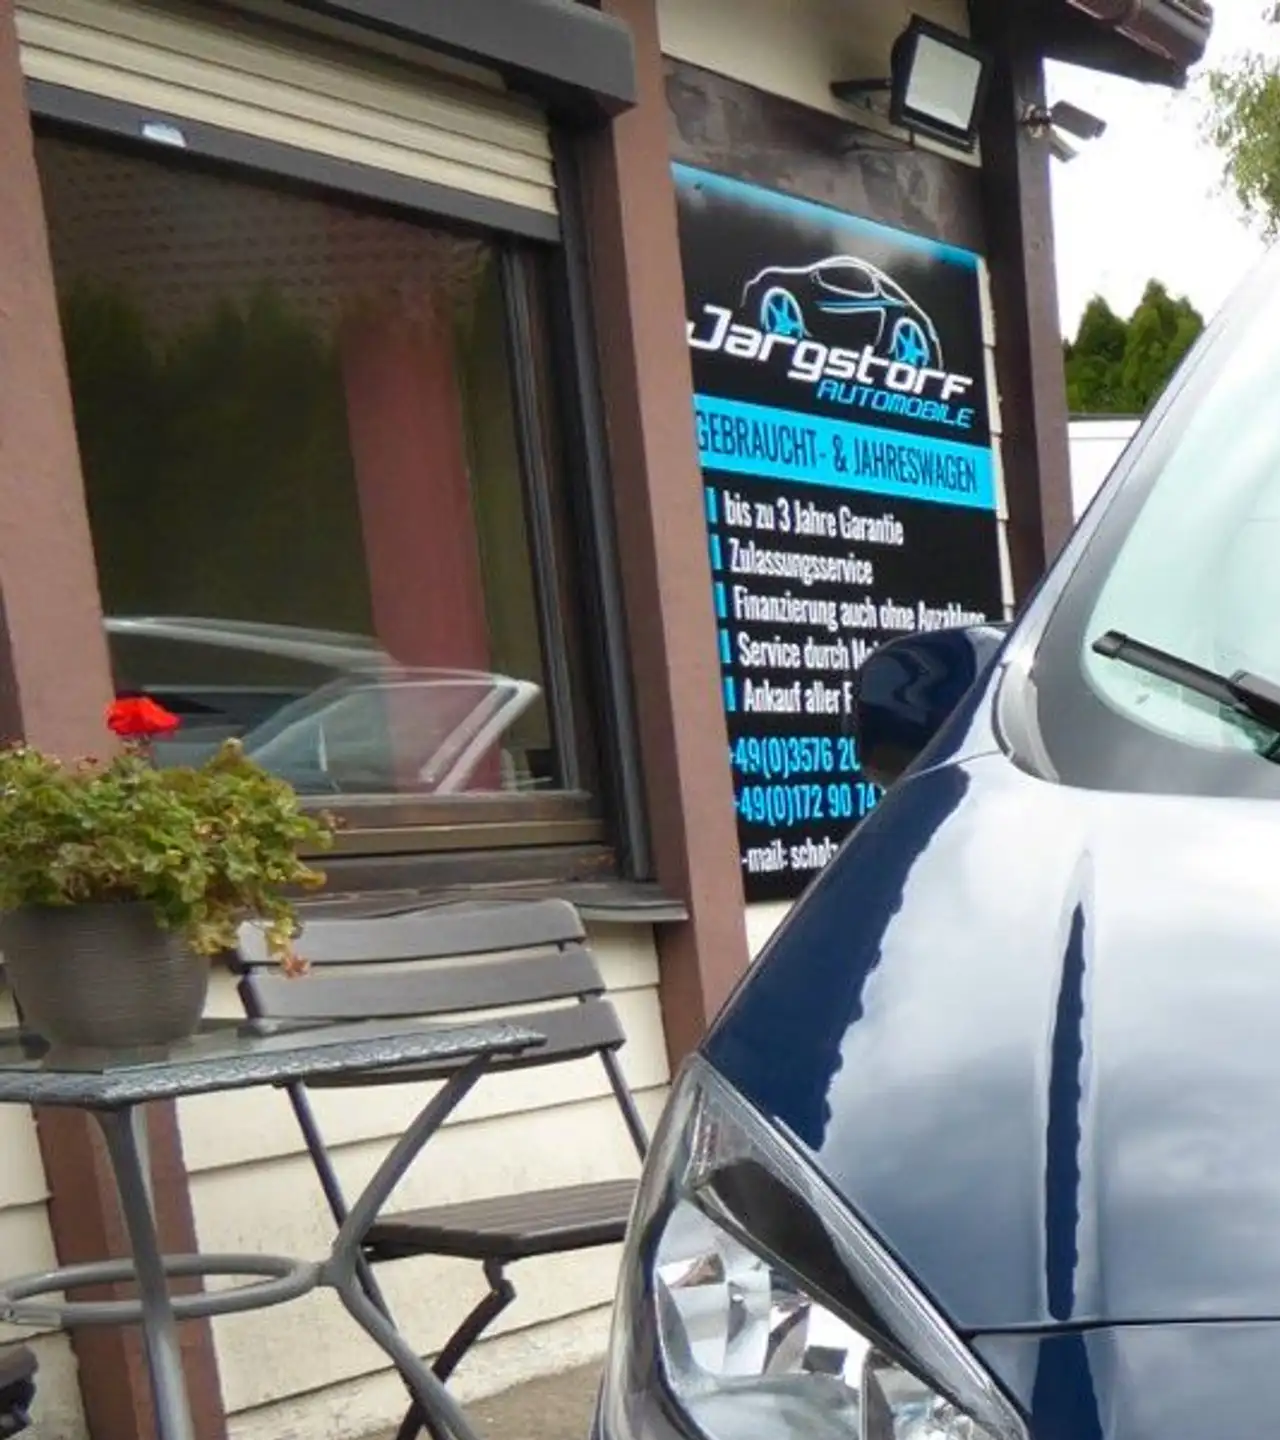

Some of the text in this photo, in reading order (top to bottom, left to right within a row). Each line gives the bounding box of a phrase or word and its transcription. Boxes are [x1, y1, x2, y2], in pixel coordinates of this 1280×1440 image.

[696, 411, 977, 493] GEBRAUCHT- & JAHRESWAGEN
[724, 490, 904, 545] bis zu 3 Jahre Garantie
[729, 538, 873, 586] Zulassungsservice
[734, 586, 838, 631] Finanzierung
[841, 595, 877, 629] auch
[880, 599, 915, 630] ohne
[738, 633, 801, 669] Service
[804, 638, 849, 671] durch
[743, 681, 802, 713] Ankauf
[804, 684, 840, 714] aller
[827, 784, 852, 818] 90
